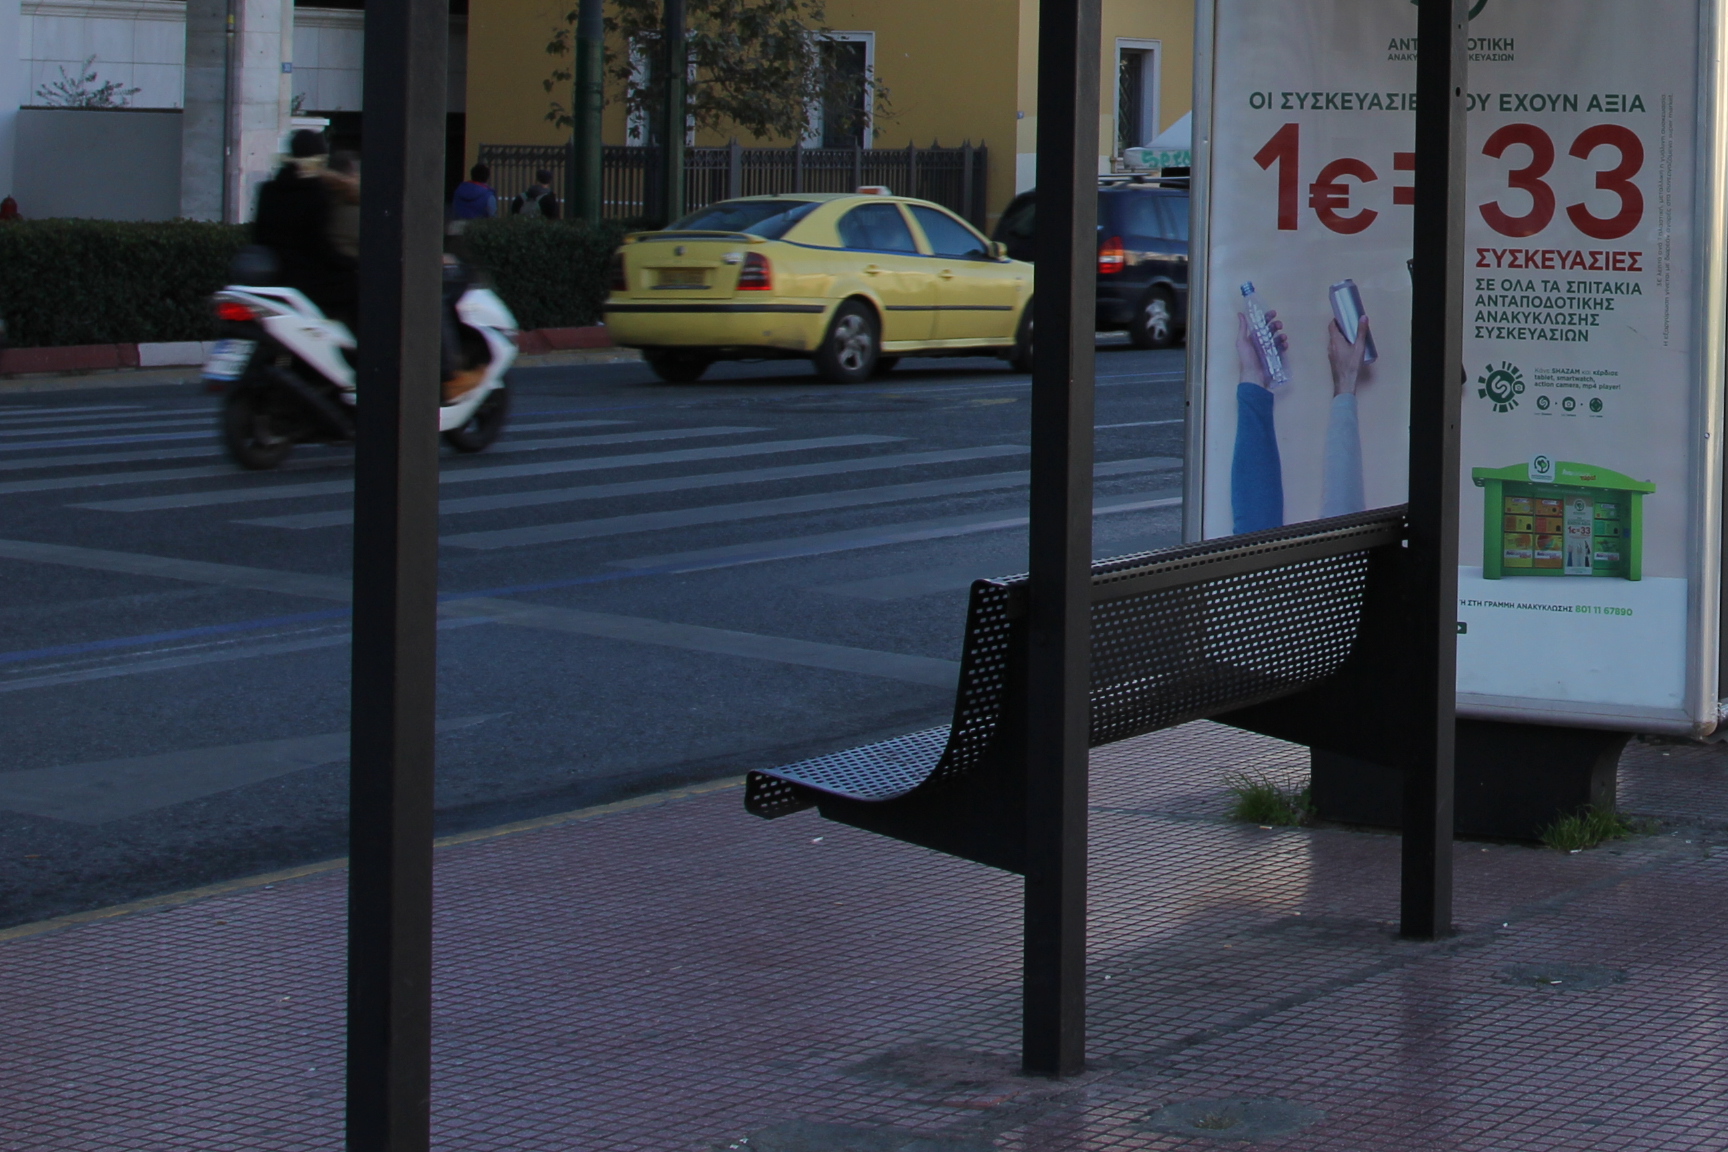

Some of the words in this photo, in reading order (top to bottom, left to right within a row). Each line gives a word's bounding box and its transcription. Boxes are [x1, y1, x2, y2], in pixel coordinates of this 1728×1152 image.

[1249, 91, 1273, 110] ΟΙ
[1499, 93, 1578, 113] ΕΧΟΥΝ
[1586, 94, 1646, 113] ΑΞΙΑ
[1475, 248, 1643, 272] ΣΥΣΚΕΥΑΣΙΕΣ
[1475, 278, 1496, 291] ΣΕ
[1501, 279, 1536, 292] ΟΛΑ
[1541, 280, 1561, 293] ΤΑ
[1566, 281, 1643, 295] ΣΠΙΤΑΚΙΑ
[1475, 294, 1615, 311] ΑΝΤΑΠΟΔΟΤΙΚΗΣ
[1475, 310, 1600, 326] ΑΝΑΚΥΚΛΩΣΗΣ
[1475, 326, 1589, 342] ΣΥΣΚΕΥΑΣΙΩΝ
[1484, 600, 1515, 609] ΓΡΑΜΜΗ
[1516, 603, 1573, 612] ΑΝΑΚΥΚΛΩΣΗΣ
[1575, 605, 1591, 613] 801
[1593, 606, 1601, 614] 11
[1603, 607, 1633, 616] 67890
